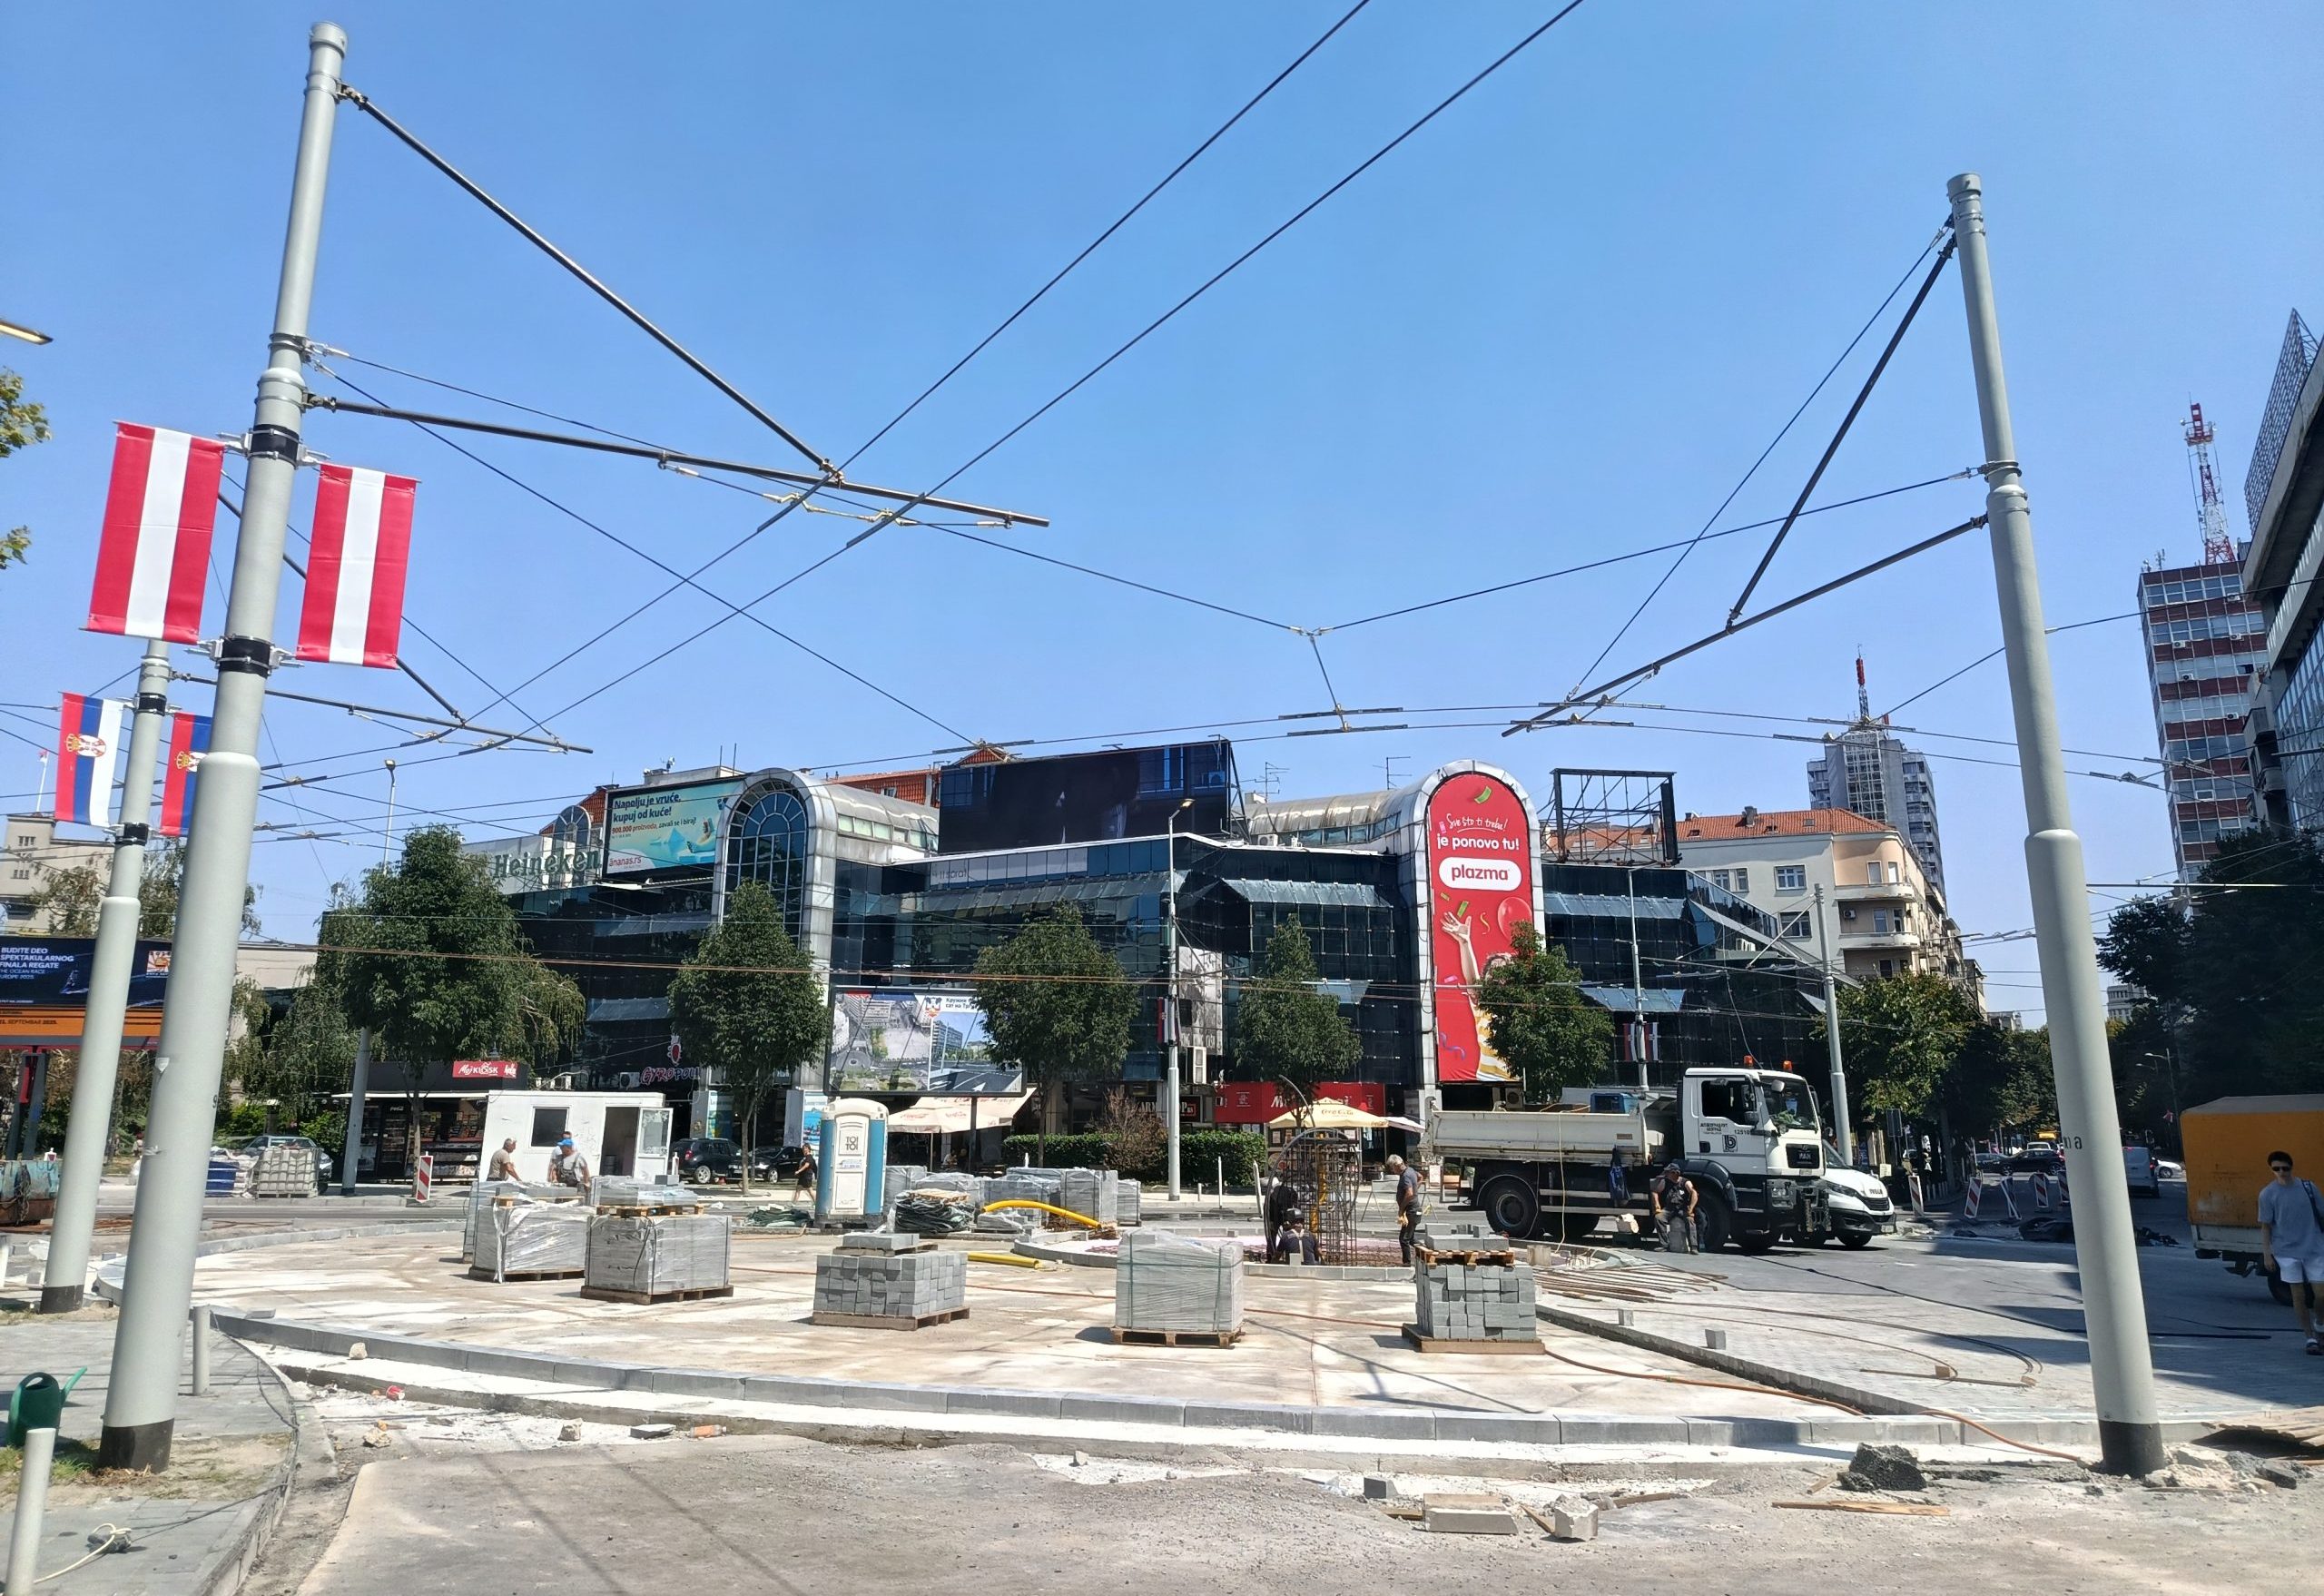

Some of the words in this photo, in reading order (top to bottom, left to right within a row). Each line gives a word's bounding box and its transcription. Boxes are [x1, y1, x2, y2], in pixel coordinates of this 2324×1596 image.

[615, 795, 645, 811] Napolju
[645, 795, 655, 808] je
[613, 811, 635, 823] kupuj
[638, 809, 648, 819] od
[649, 806, 672, 818] kuće!
[1446, 813, 1462, 830] Sve
[1462, 816, 1475, 827] što
[1476, 816, 1483, 827] ti
[1485, 817, 1509, 832] treba!
[1436, 832, 1450, 850] je
[1452, 835, 1500, 850] ponovo
[1502, 837, 1521, 851] tu!
[494, 847, 601, 878] Heineken
[1451, 863, 1510, 881] plazma
[0, 954, 74, 962] SPEKTAKULARNOG
